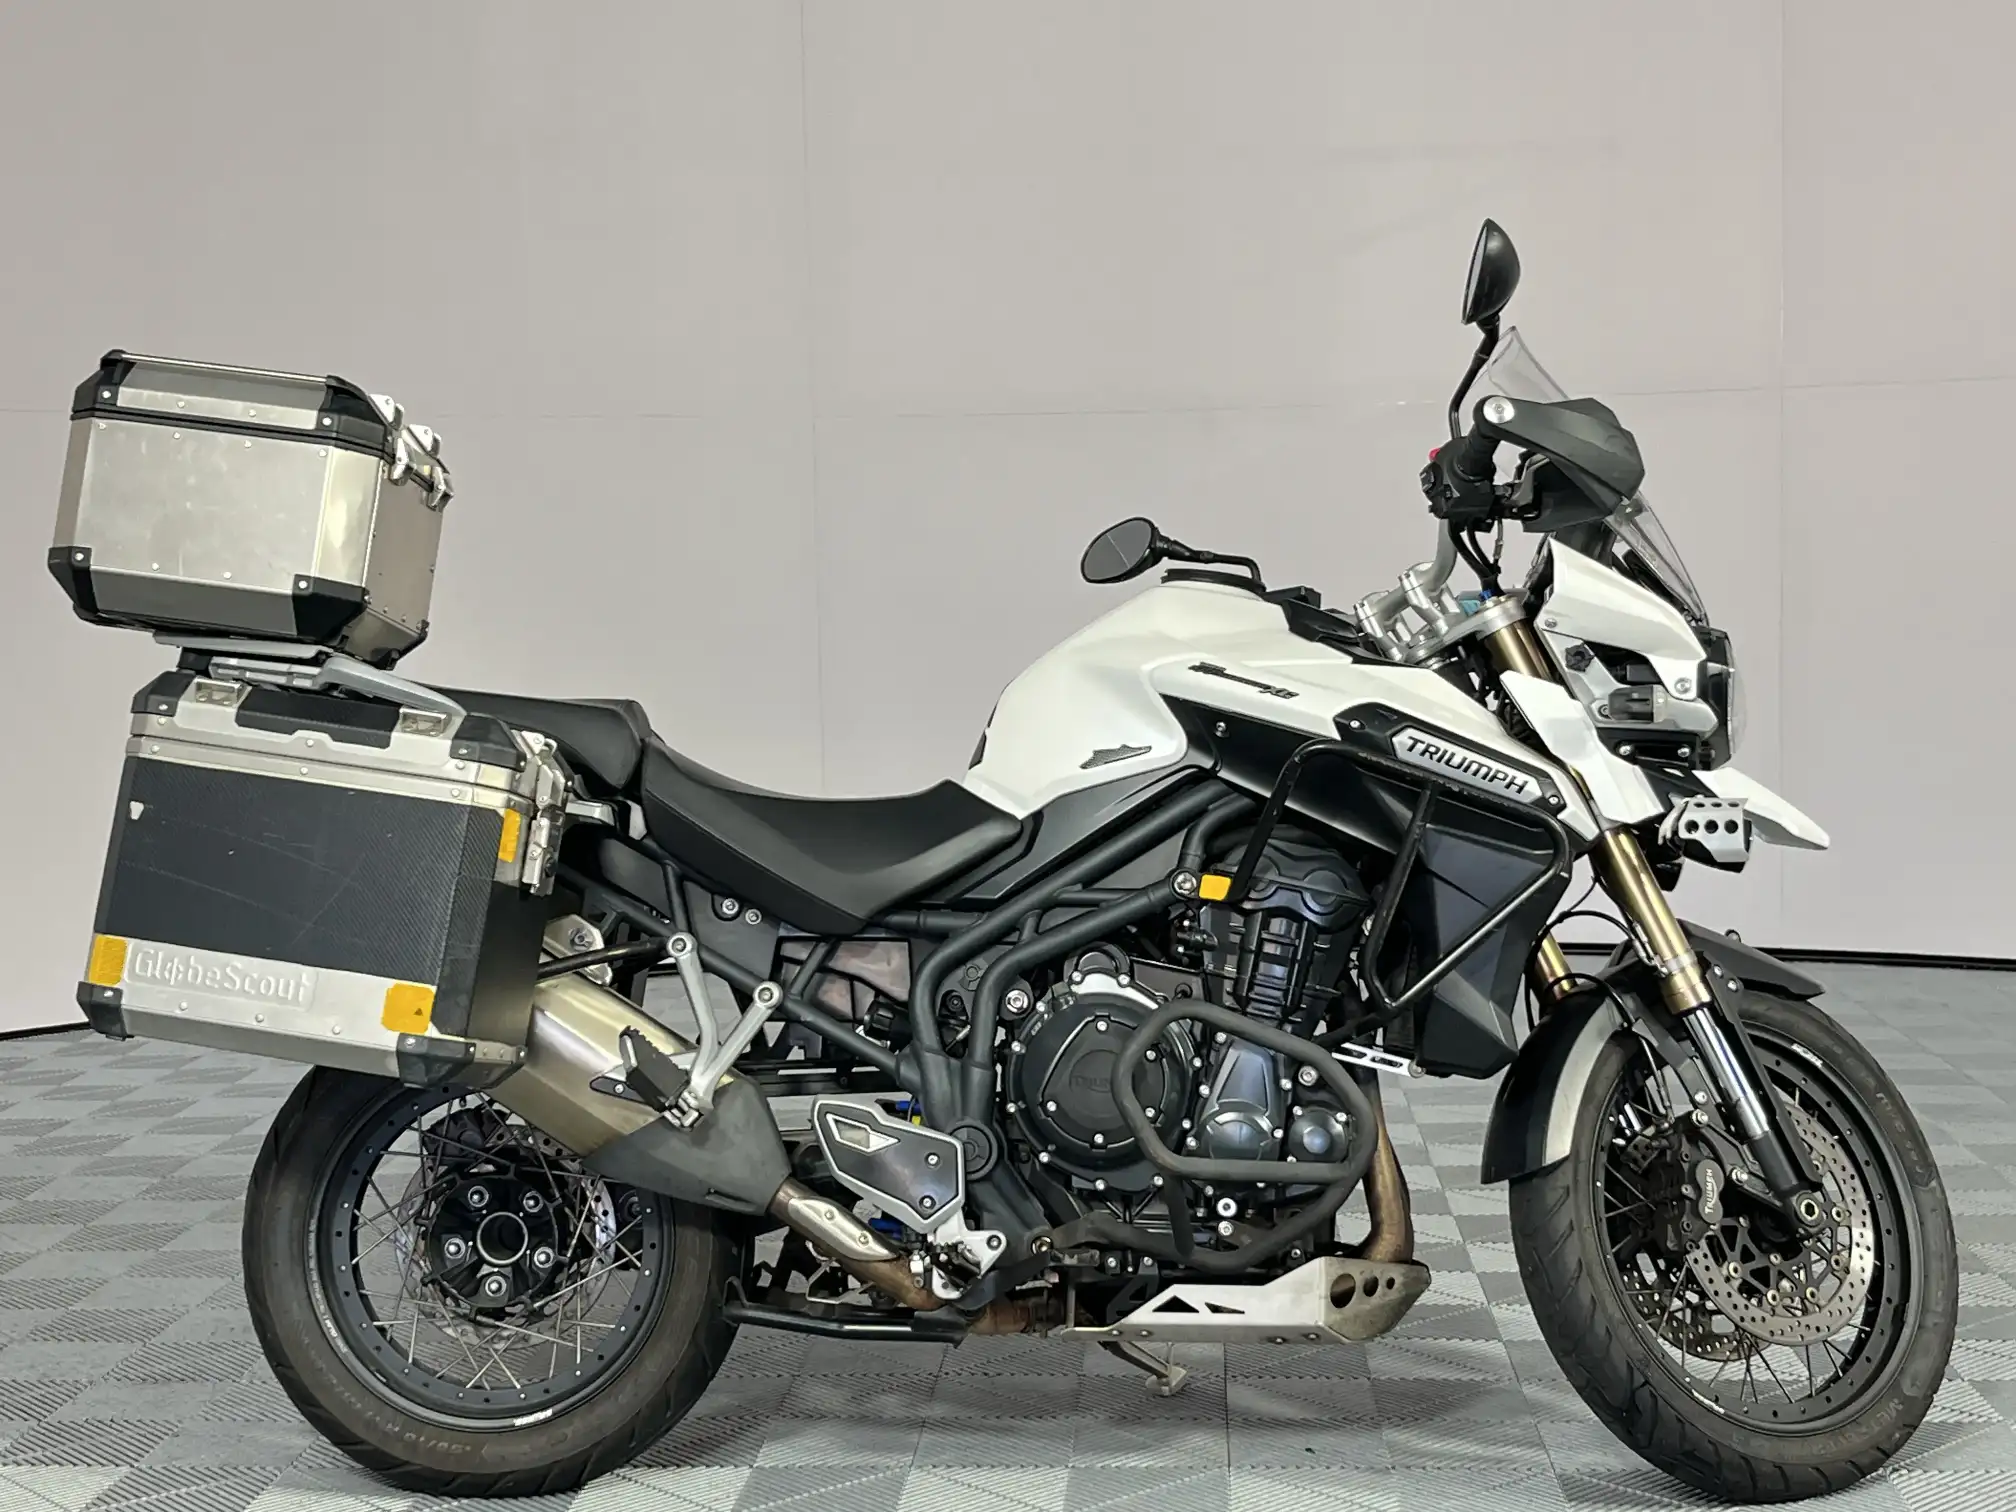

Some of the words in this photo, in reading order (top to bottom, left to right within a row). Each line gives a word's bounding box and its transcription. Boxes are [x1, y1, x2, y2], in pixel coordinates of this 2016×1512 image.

[1406, 735, 1529, 795] TRIUMPH
[134, 948, 311, 1002] GlobeScout
[1704, 1168, 1716, 1214] TRIUMPH
